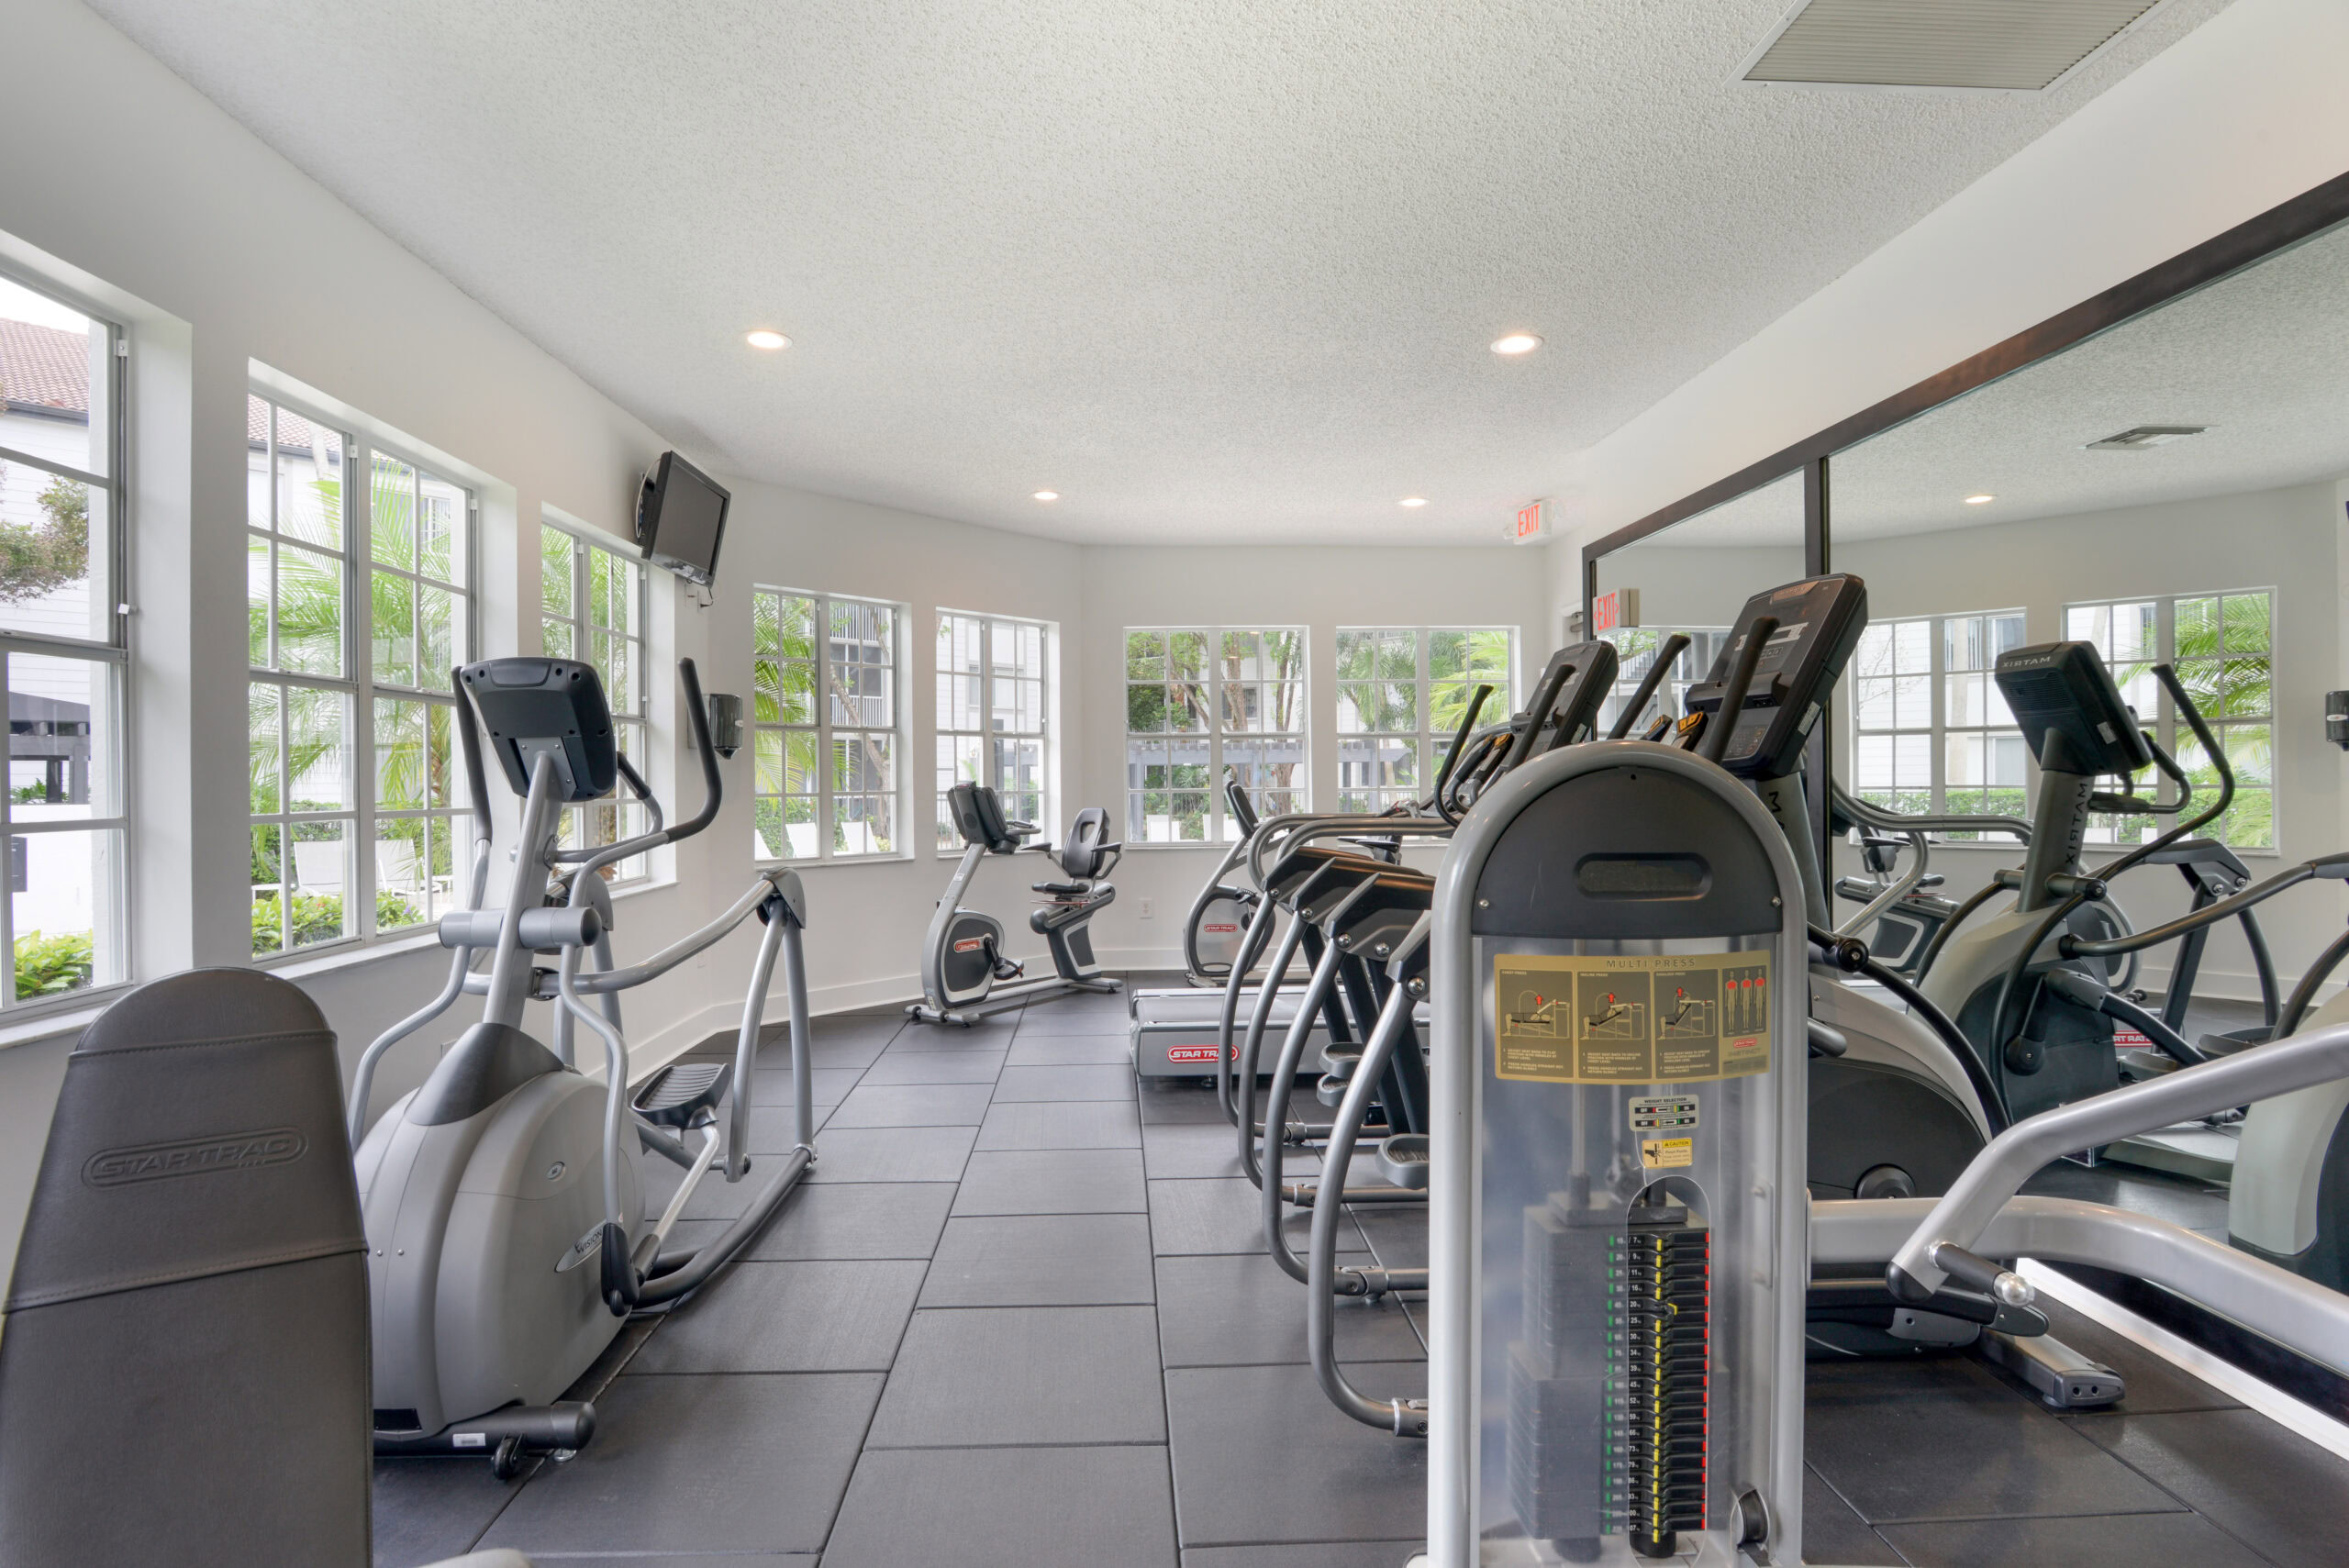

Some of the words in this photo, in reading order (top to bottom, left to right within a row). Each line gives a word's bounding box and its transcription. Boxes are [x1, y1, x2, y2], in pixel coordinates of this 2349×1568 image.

[1518, 504, 1540, 538] EXIT
[1598, 592, 1617, 631] EXIT
[1607, 960, 1647, 968] MULTI
[1654, 959, 1696, 968] PRESS
[95, 1151, 192, 1179] STAR
[197, 1139, 290, 1163] TRAC
